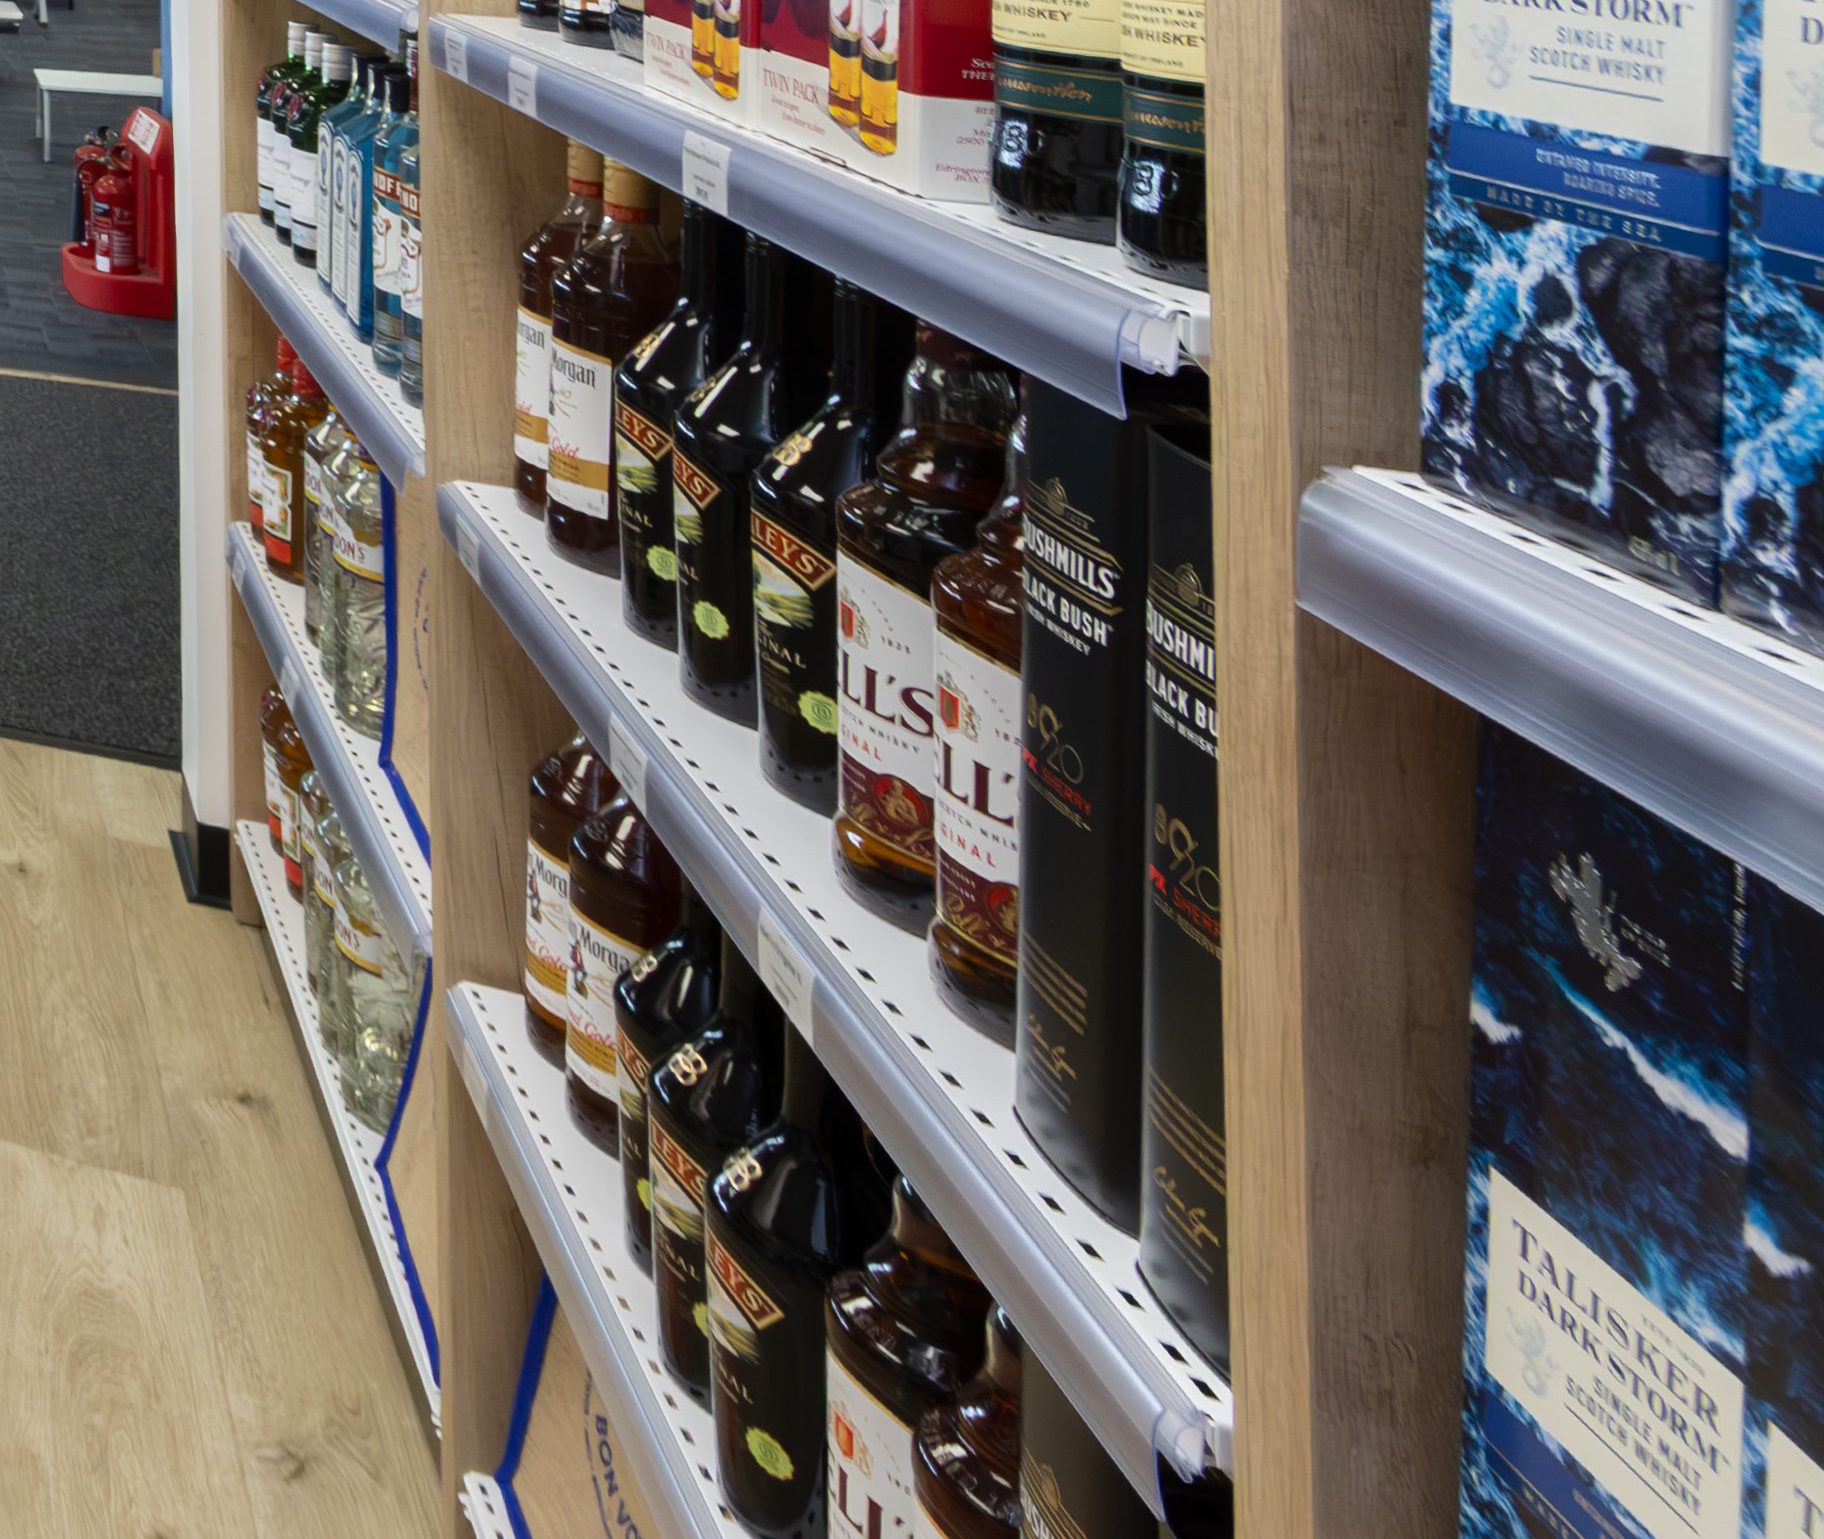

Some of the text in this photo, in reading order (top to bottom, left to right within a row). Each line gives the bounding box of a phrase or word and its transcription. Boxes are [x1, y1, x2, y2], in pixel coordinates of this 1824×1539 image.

[1004, 5, 1072, 23] WHISKEY
[1557, 25, 1667, 60] SINGLE MALT
[1529, 46, 1667, 86] SCOTCH WHISKY
[1060, 596, 1109, 648] BUSH
[1511, 1218, 1722, 1439] TALISKER
[1517, 1269, 1603, 1366] DARK
[594, 1414, 619, 1498] BON
[1564, 1374, 1702, 1517] SCOTCH WHISKY
[1592, 1375, 1703, 1492] SINGLE MALT
